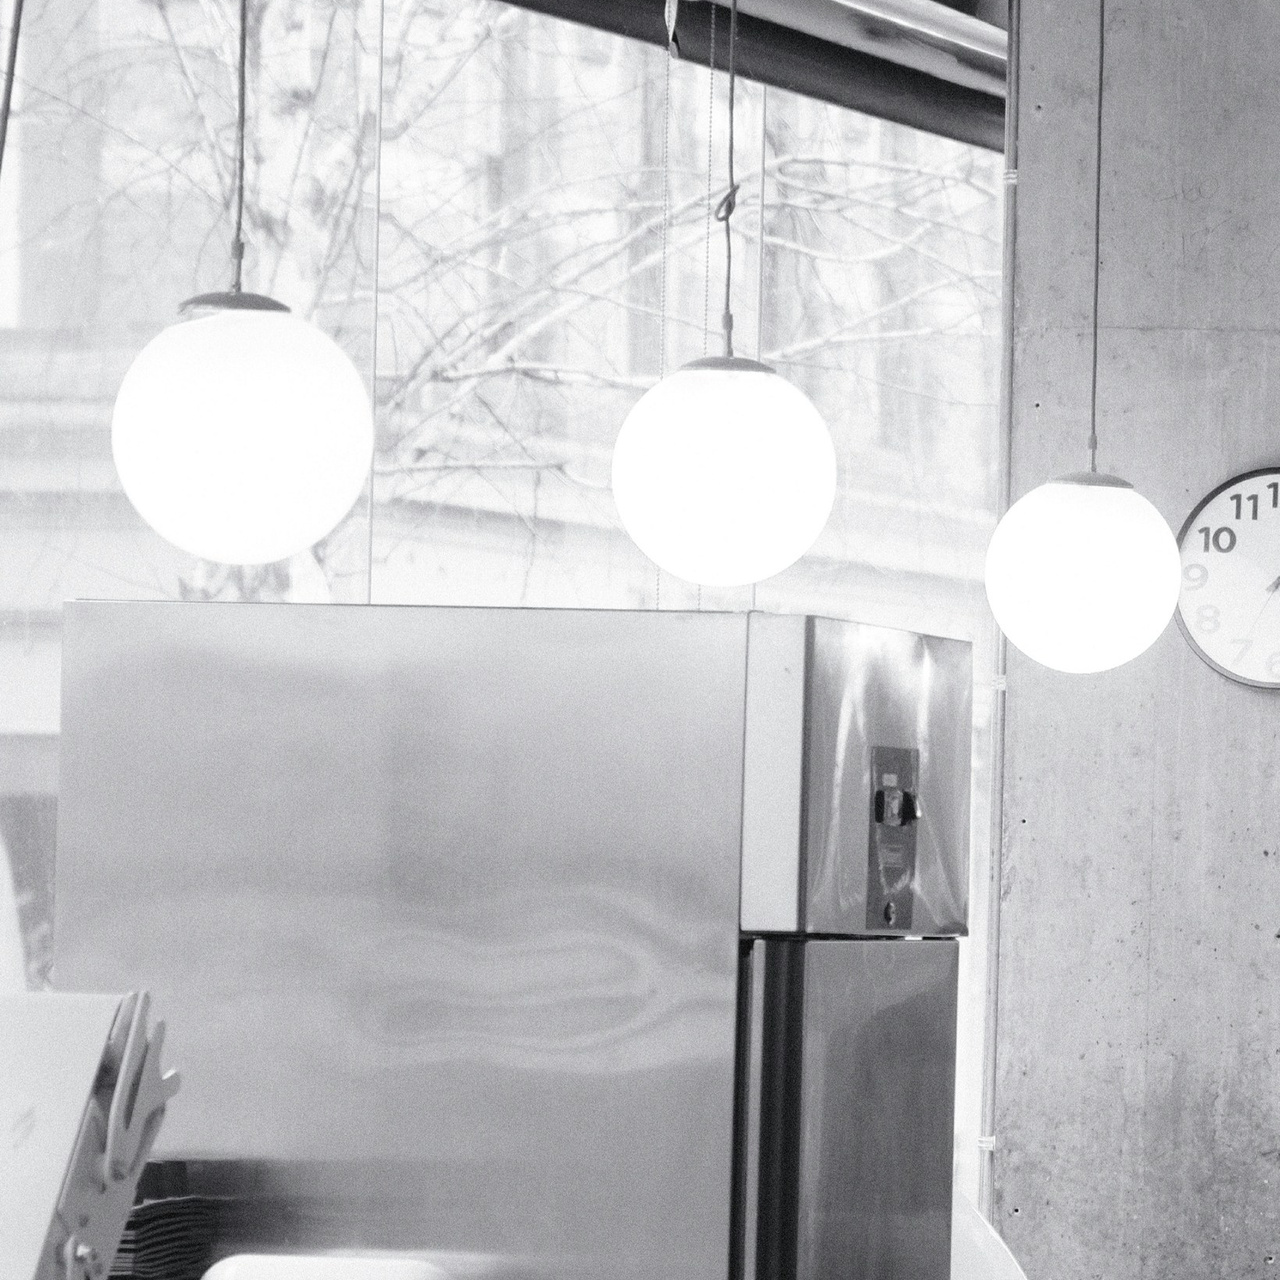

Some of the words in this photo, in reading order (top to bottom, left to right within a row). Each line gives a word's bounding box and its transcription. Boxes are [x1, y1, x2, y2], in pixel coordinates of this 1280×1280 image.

[1229, 493, 1259, 521] 11
[1197, 526, 1237, 553] 10
[1183, 563, 1209, 591] 9
[1195, 604, 1221, 634] 8
[1230, 638, 1254, 667] 7
